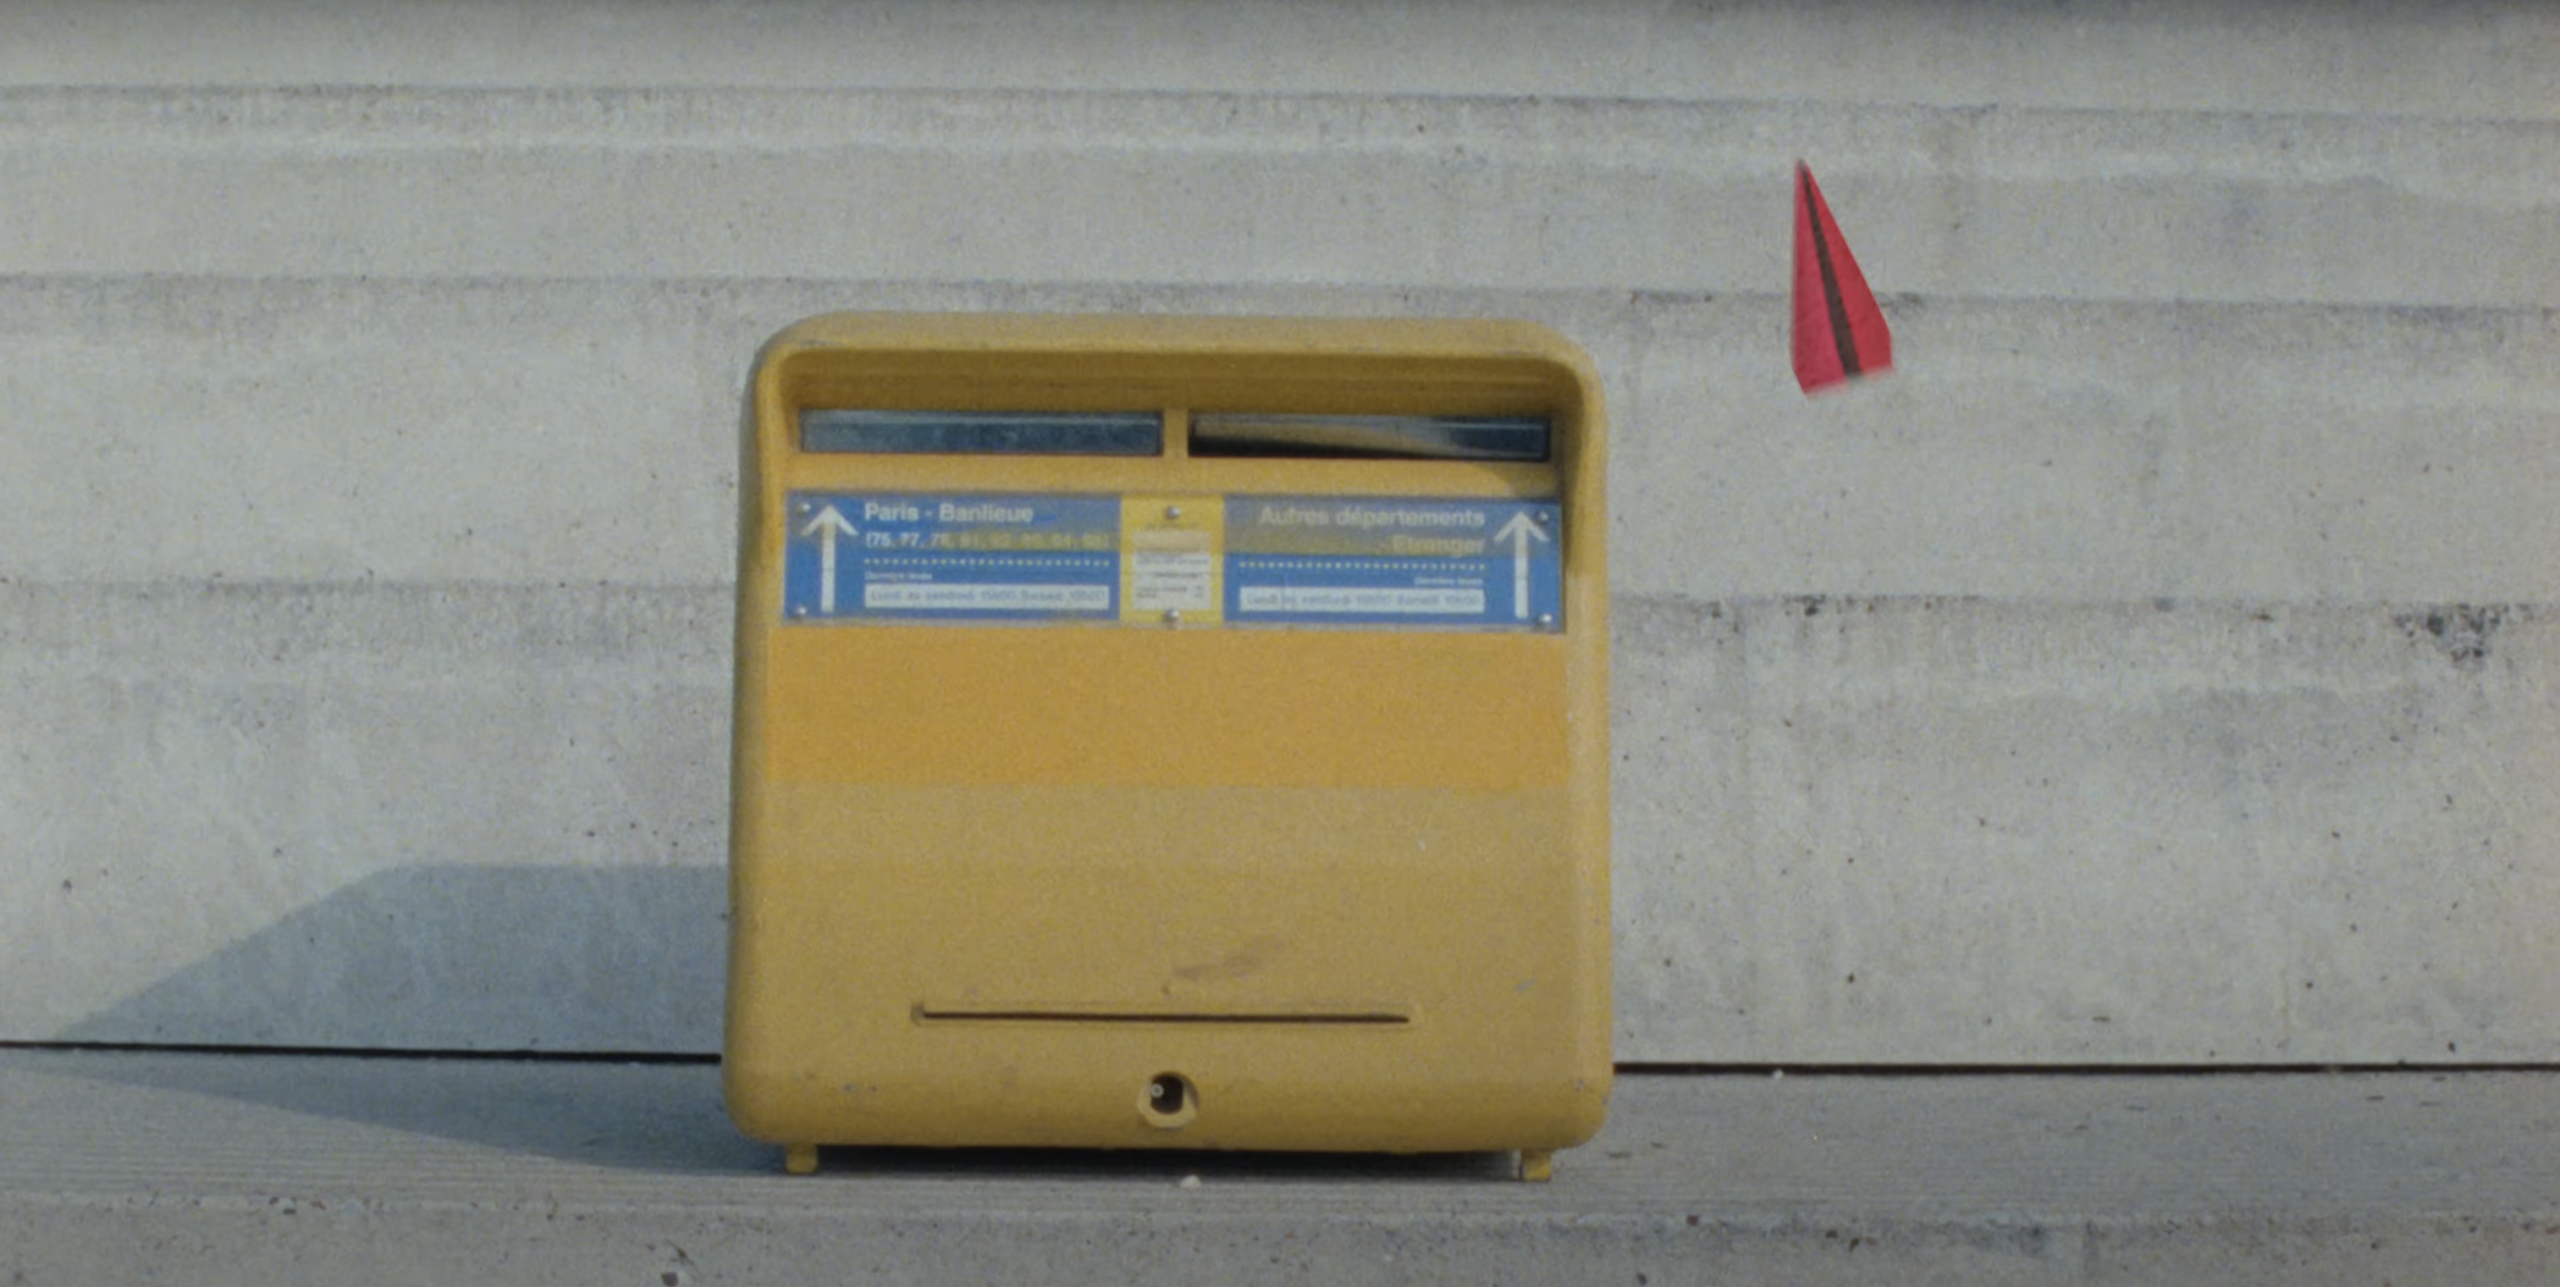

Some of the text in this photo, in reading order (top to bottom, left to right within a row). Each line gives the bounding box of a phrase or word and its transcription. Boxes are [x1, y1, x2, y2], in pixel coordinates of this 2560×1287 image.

[864, 502, 919, 522] Paris
[938, 502, 1034, 523] Banlieue
[1259, 505, 1486, 530] Autres départements
